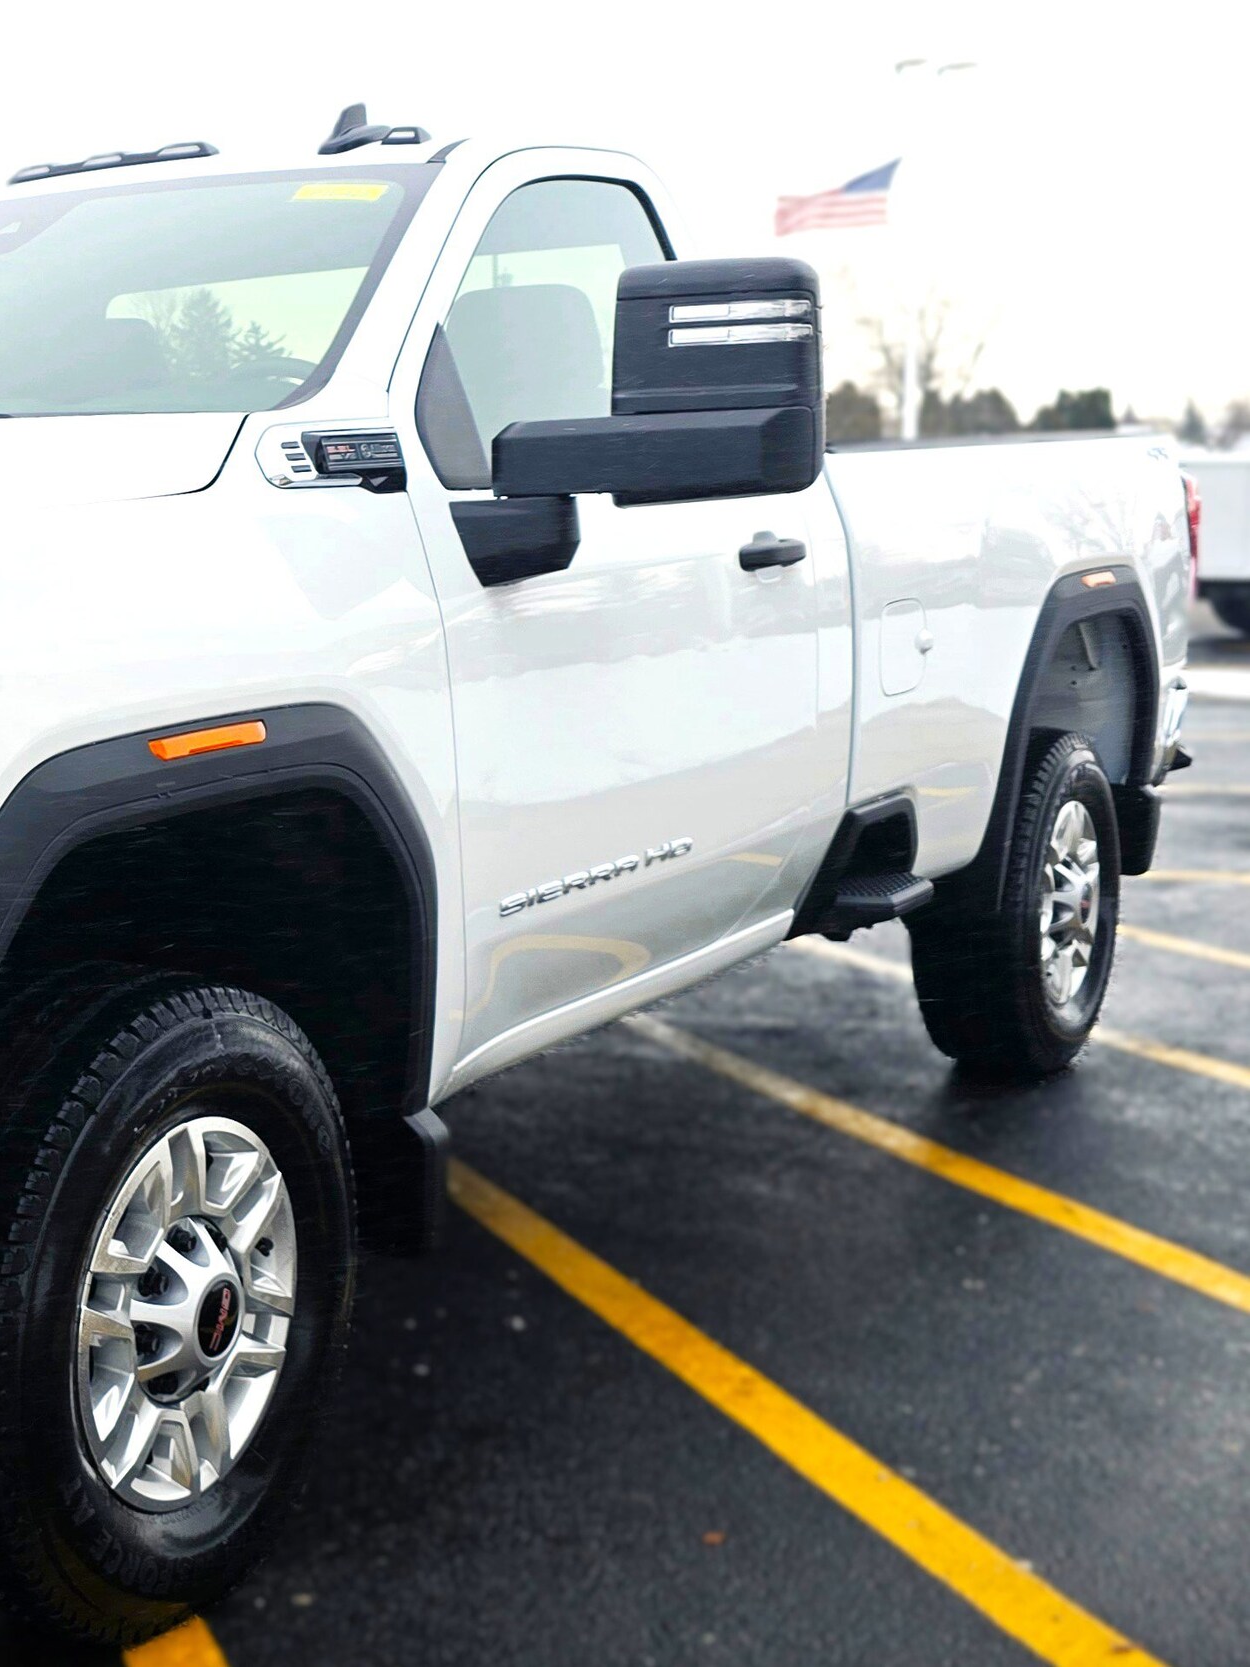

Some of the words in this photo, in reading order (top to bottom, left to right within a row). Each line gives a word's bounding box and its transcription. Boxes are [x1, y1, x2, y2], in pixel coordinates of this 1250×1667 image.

[499, 854, 639, 917] SIERRA
[645, 836, 693, 867] HD
[209, 1287, 232, 1352] GMC
